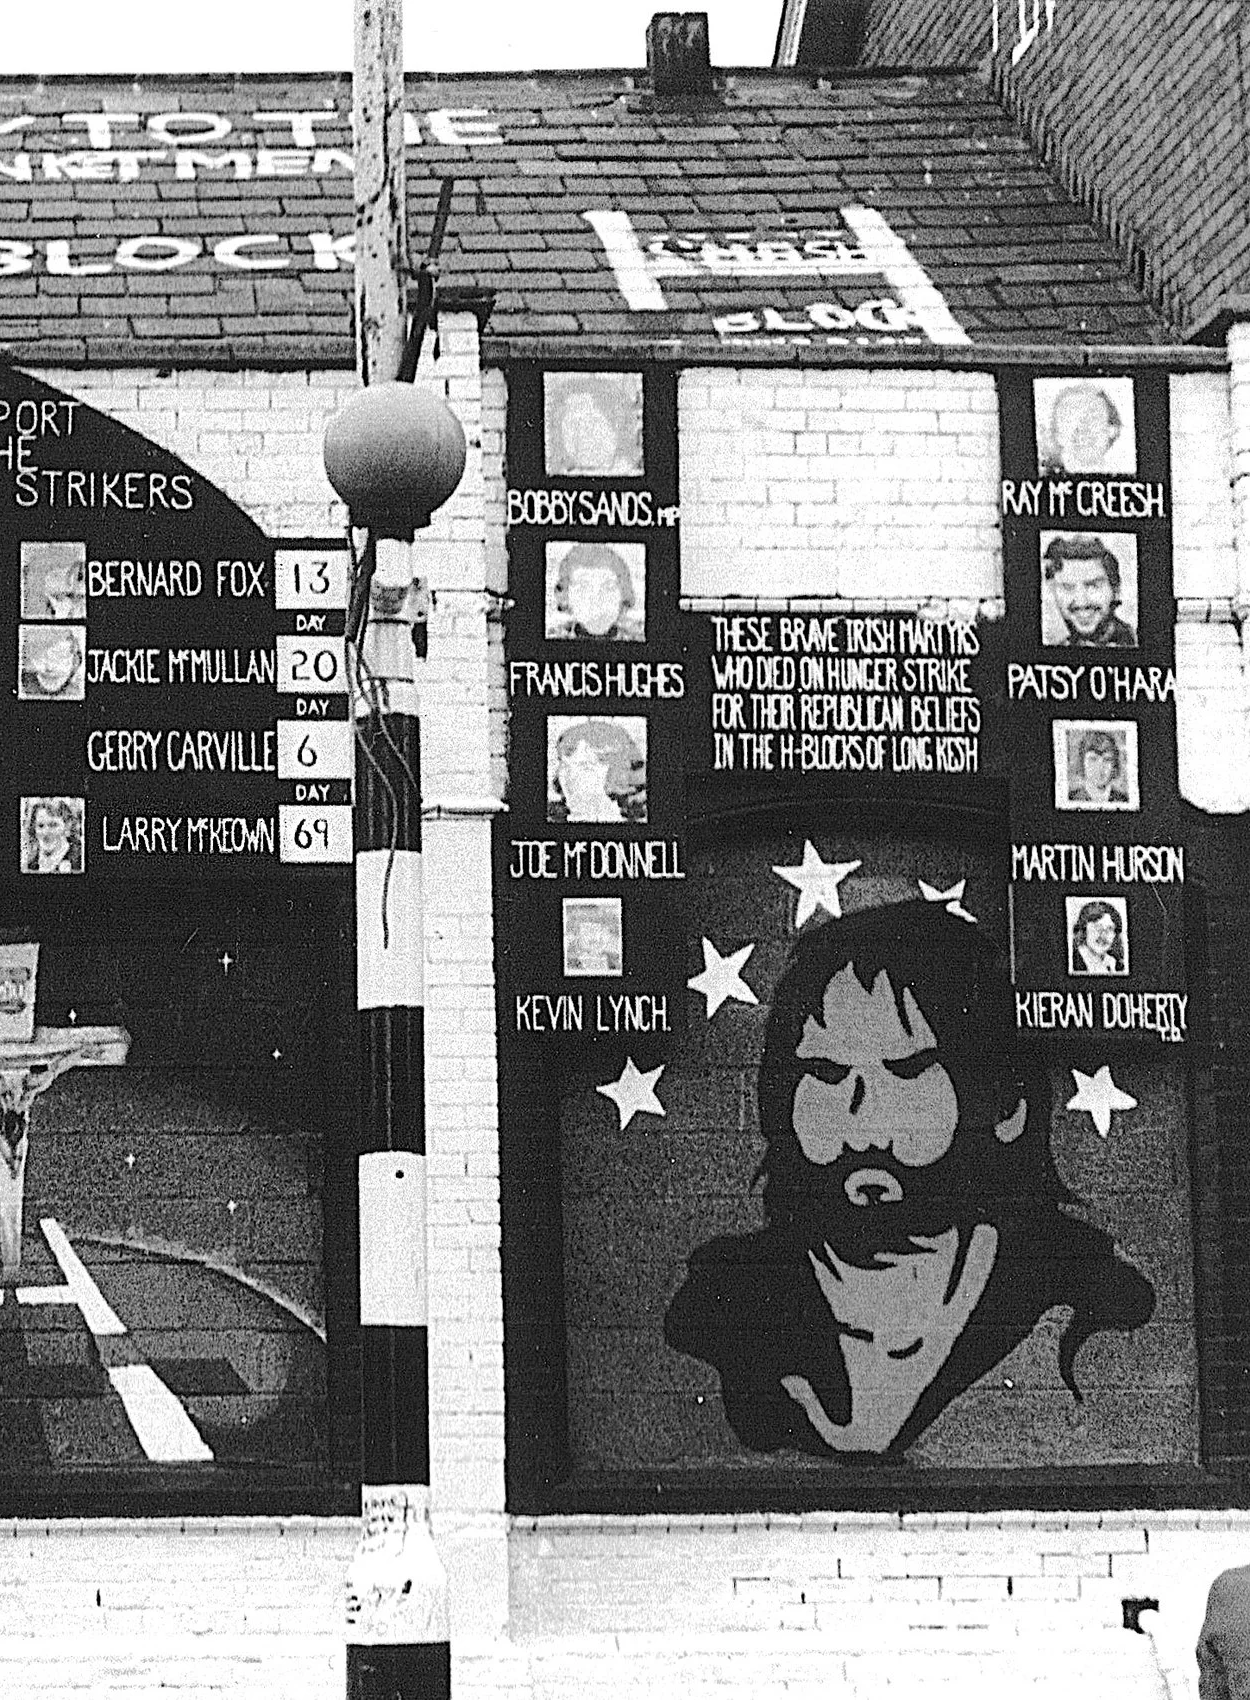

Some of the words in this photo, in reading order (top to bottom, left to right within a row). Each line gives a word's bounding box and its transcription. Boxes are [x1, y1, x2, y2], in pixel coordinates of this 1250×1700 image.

[61, 112, 233, 150] TO
[252, 108, 504, 148] TE
[15, 471, 195, 511] STRIKERS
[1001, 479, 1043, 516] RAY
[87, 560, 202, 598] BERNARD
[216, 560, 265, 598] FOX
[293, 561, 330, 595] 13
[295, 614, 327, 633] DAY
[711, 616, 775, 652] THESE
[779, 617, 840, 653] BRAVE
[845, 617, 896, 654] IRISH
[87, 649, 161, 683] JACKIE
[291, 650, 338, 682] 20
[510, 661, 603, 697] FRANCIS
[605, 662, 685, 698] HUGHES
[711, 654, 753, 690] WHO
[755, 656, 796, 691] DIED
[799, 656, 825, 691] ON
[826, 657, 899, 693] HUNGER
[901, 657, 973, 693] STRIKE
[1008, 663, 1086, 700] PATSY
[295, 699, 330, 716] DAY
[712, 692, 747, 730] FOR
[800, 694, 903, 731] REPUBLICAN
[910, 695, 981, 733] BELIEFS
[87, 730, 163, 772] GERRY
[167, 730, 275, 772] CARVILLE
[297, 734, 318, 768] 6
[713, 733, 734, 769] IN
[738, 733, 774, 770] THE
[780, 733, 865, 771] H-BLOCKS
[866, 735, 888, 771] OF
[892, 735, 934, 772] LONG
[935, 735, 979, 773] KESH
[295, 784, 331, 802] DAY
[102, 816, 183, 852] LARRY
[294, 818, 330, 850] 69
[510, 840, 558, 878] JOE
[590, 841, 686, 879] DONNELL
[1011, 844, 1095, 882] MARTIN
[1102, 845, 1185, 884] HURSON
[516, 995, 583, 1031] KEVIN
[1015, 992, 1094, 1028] KIERAN
[1102, 992, 1188, 1031] DOHERTY
